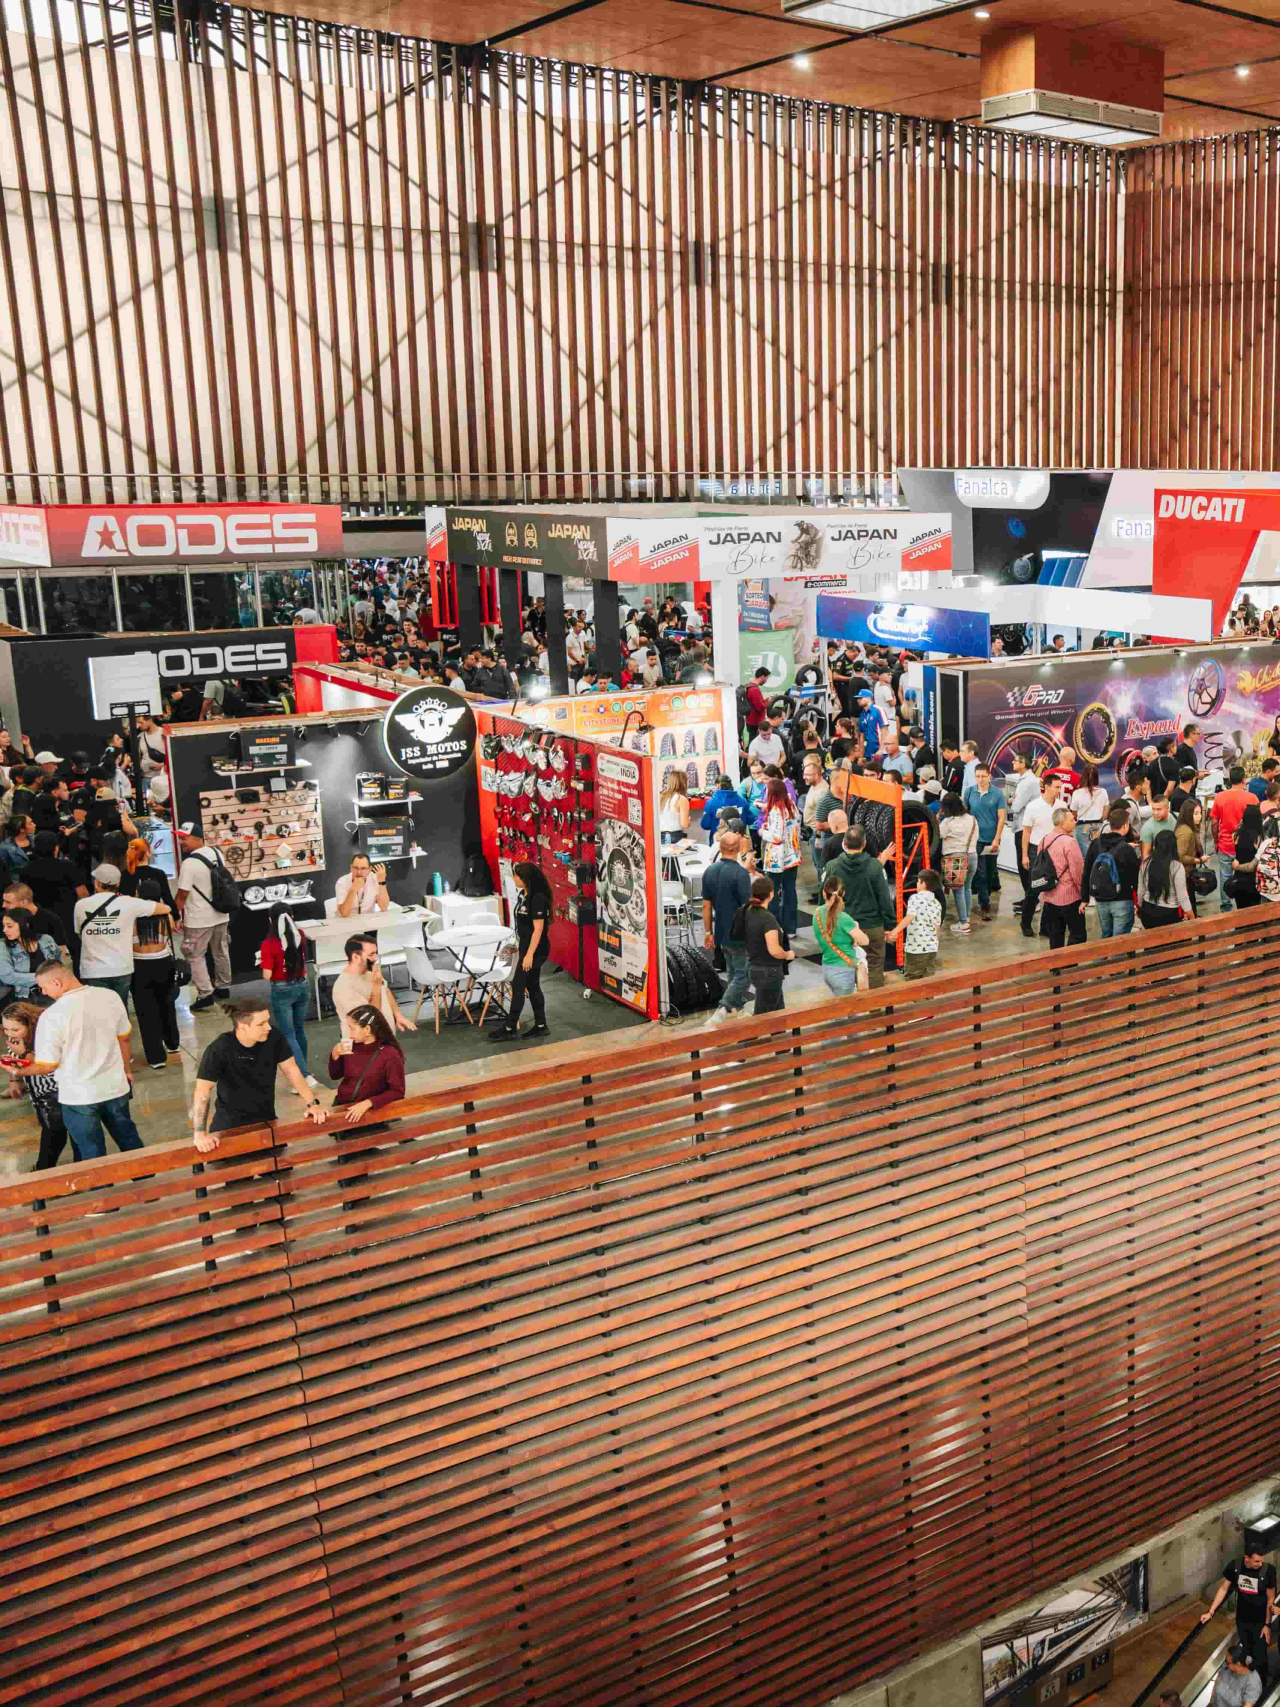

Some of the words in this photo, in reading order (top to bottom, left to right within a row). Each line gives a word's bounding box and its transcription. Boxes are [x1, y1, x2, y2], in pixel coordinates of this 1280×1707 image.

[956, 478, 1008, 497] Fanalca
[1158, 495, 1246, 523] DUCATI
[452, 517, 487, 533] JAPAN
[547, 523, 591, 540] JAPAN
[81, 513, 319, 558] AODES
[613, 534, 632, 551] JAPAN
[649, 533, 689, 554] JAPAN
[709, 531, 782, 545] JAPAN
[831, 529, 898, 541] JAPAN
[909, 527, 942, 545] JAPAN
[613, 550, 633, 567] JAPAN
[650, 549, 690, 570] JAPAN
[726, 543, 776, 575] Bike
[846, 541, 893, 570] Bike
[909, 542, 943, 560] JAPAN
[140, 642, 288, 678] ODES
[1126, 713, 1183, 738] Expand
[401, 746, 421, 761] JSS
[426, 740, 467, 755] MOTOS
[620, 767, 636, 780] INDIA
[86, 925, 121, 936] adidas
